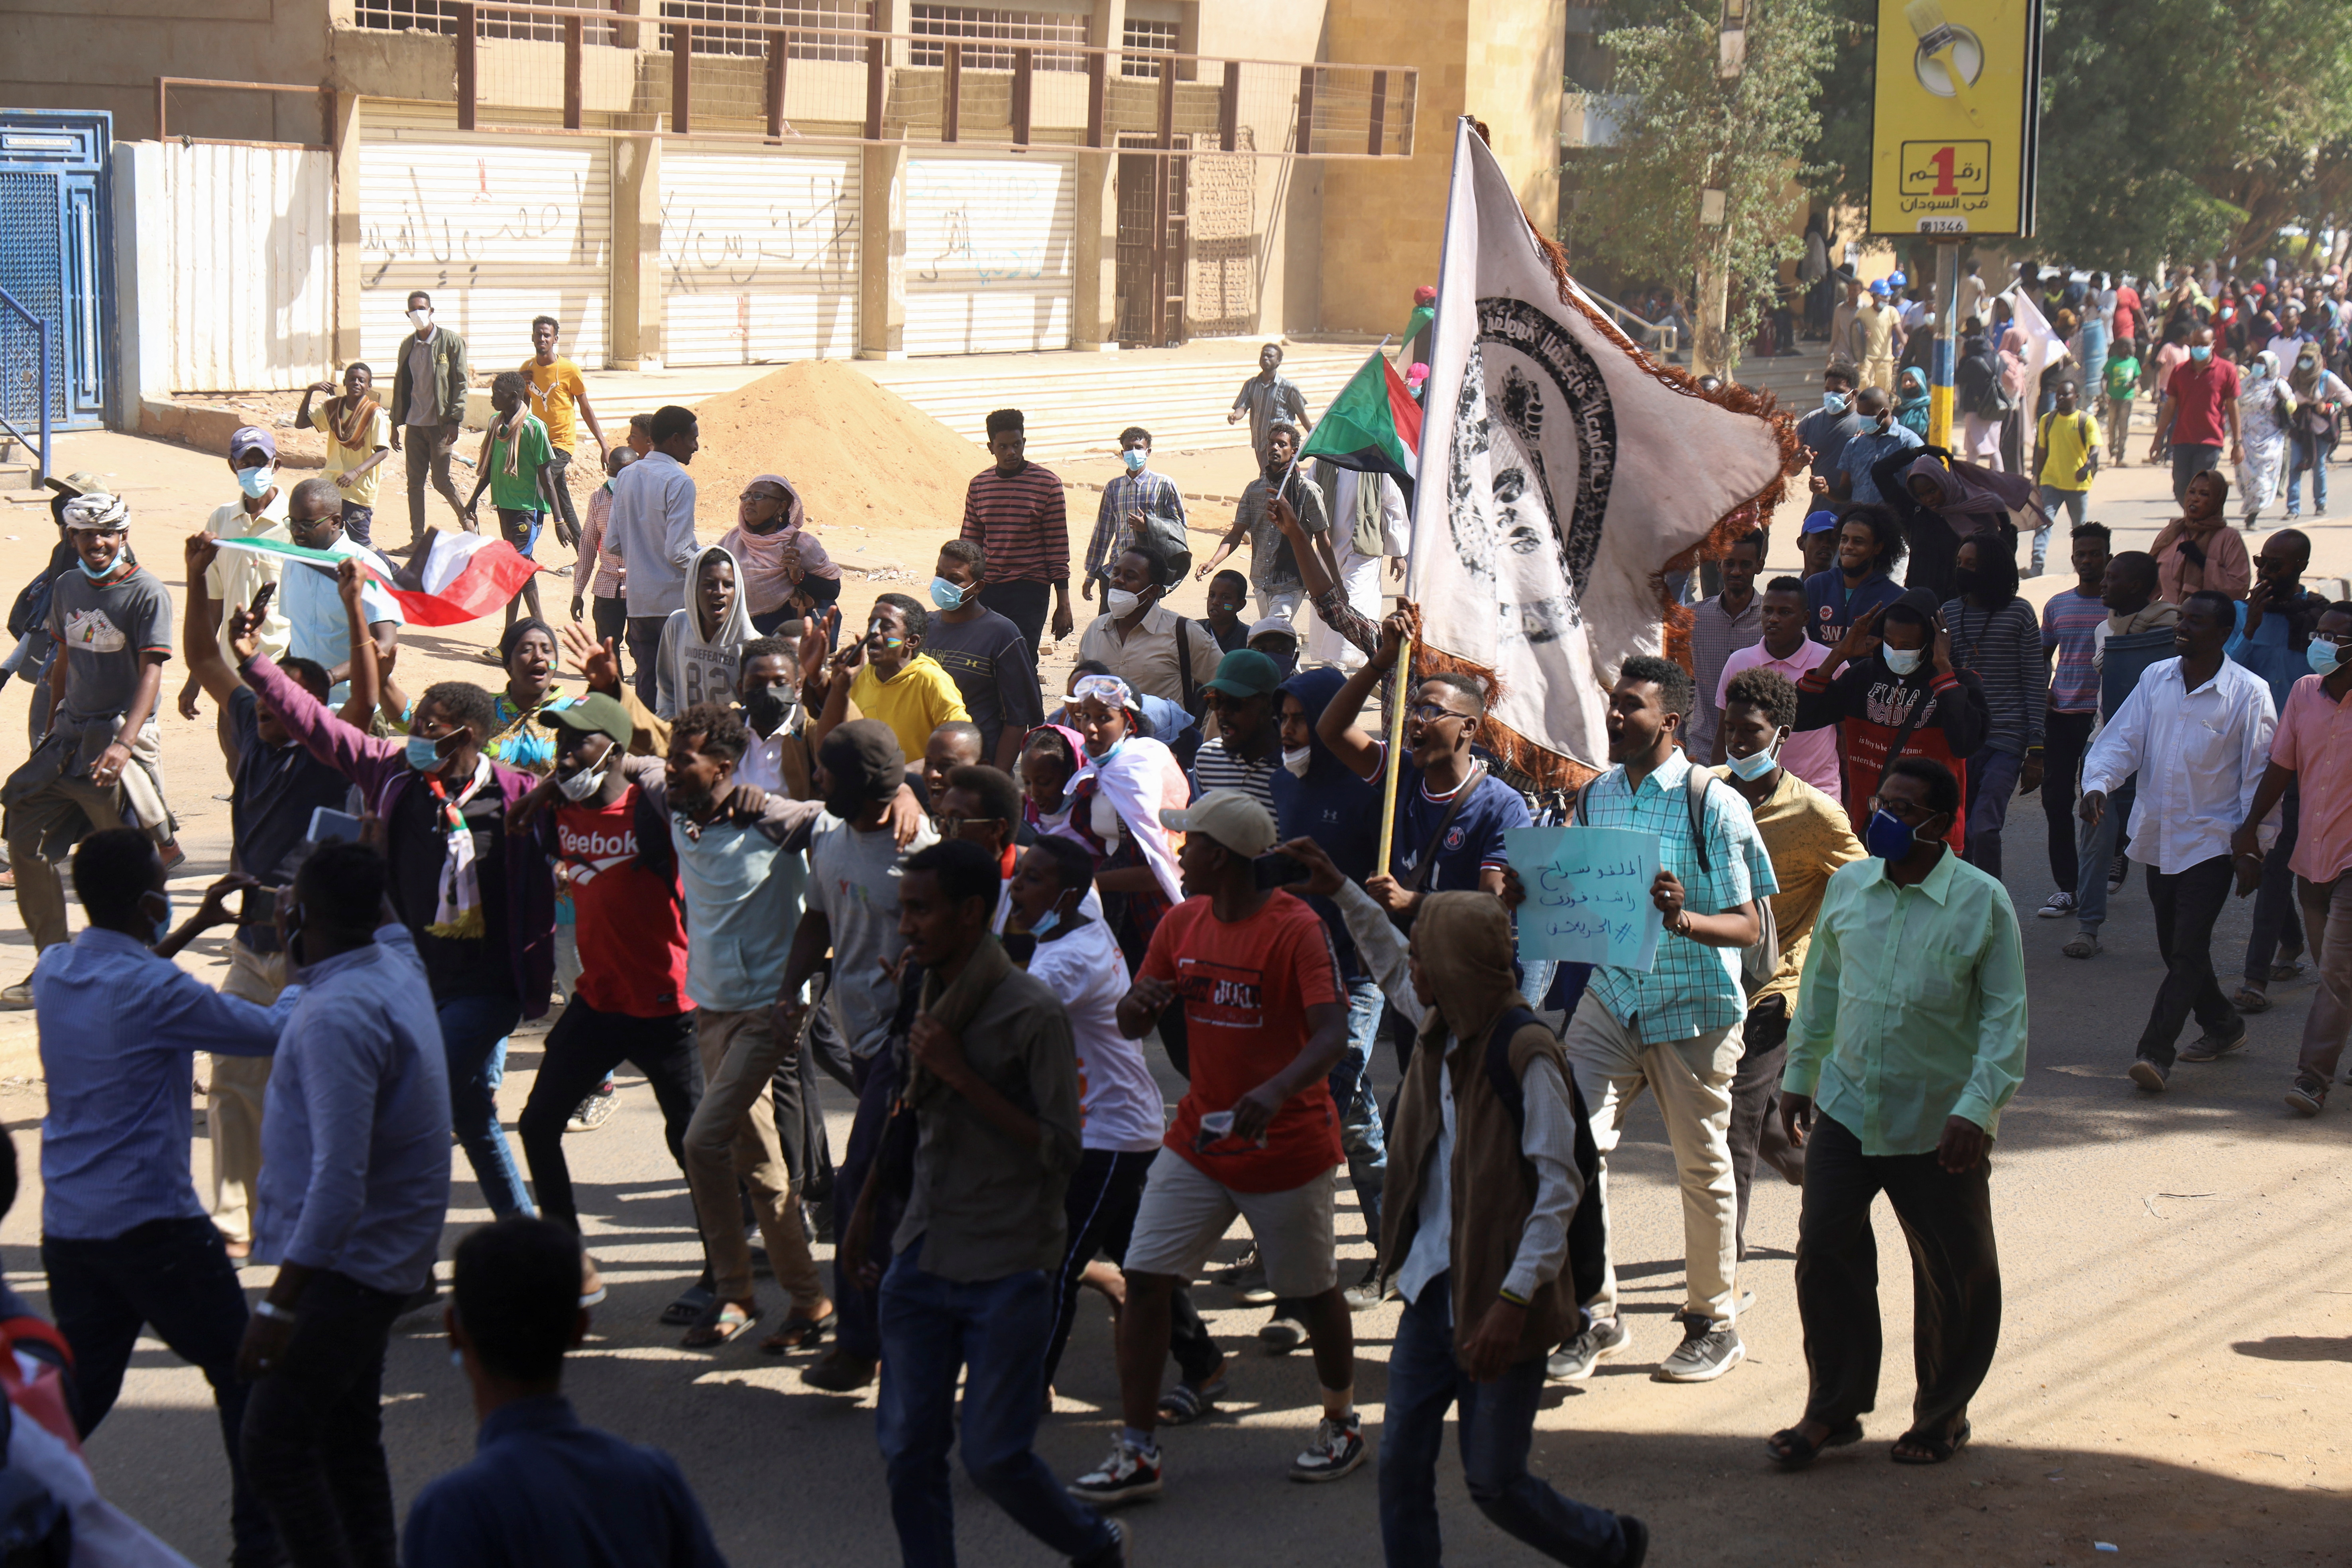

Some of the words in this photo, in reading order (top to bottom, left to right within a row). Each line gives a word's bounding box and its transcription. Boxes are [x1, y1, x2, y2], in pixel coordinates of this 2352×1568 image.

[1932, 147, 1958, 195] 1
[1901, 197, 1960, 212] السودان
[1934, 221, 1963, 232] 1346
[684, 646, 735, 667] UNDEFEATED
[1849, 755, 1869, 765] enters
[559, 824, 639, 855] Reebok
[1537, 860, 1590, 891] سراح
